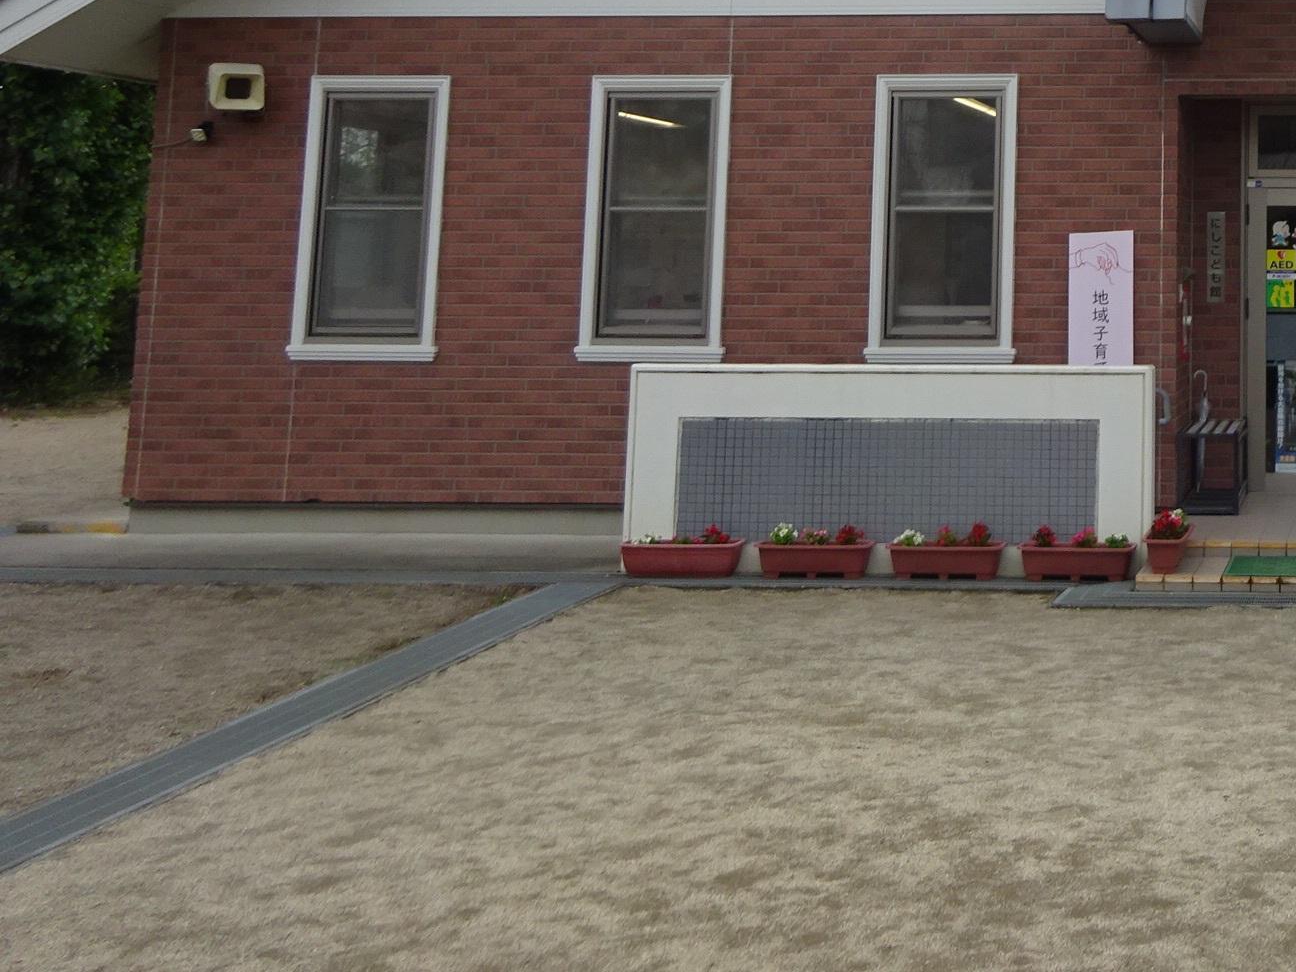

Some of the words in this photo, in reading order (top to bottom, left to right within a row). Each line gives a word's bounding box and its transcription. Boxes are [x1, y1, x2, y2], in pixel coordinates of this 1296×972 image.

[1270, 261, 1293, 269] AED
[1092, 289, 1110, 366] 地域子育
